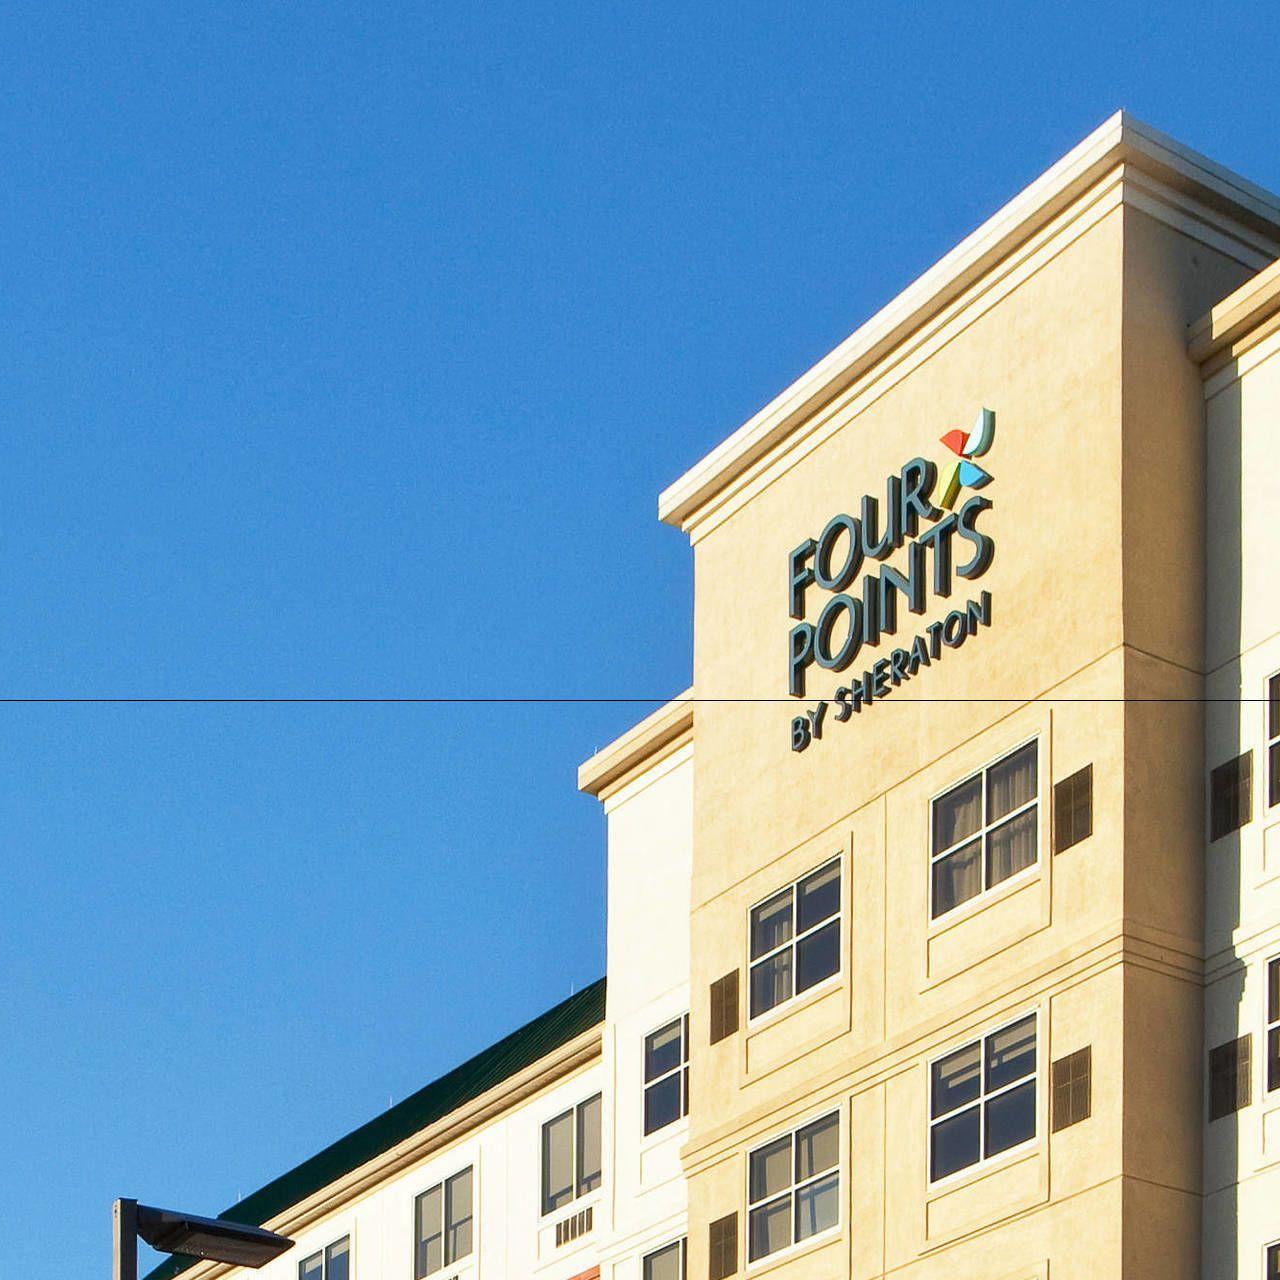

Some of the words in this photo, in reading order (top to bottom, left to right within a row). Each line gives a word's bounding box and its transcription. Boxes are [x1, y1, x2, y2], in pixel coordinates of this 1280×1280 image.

[789, 457, 945, 621] FOUR
[789, 496, 995, 699] POINTS
[791, 701, 828, 753] BY
[834, 590, 992, 723] SHERATON
